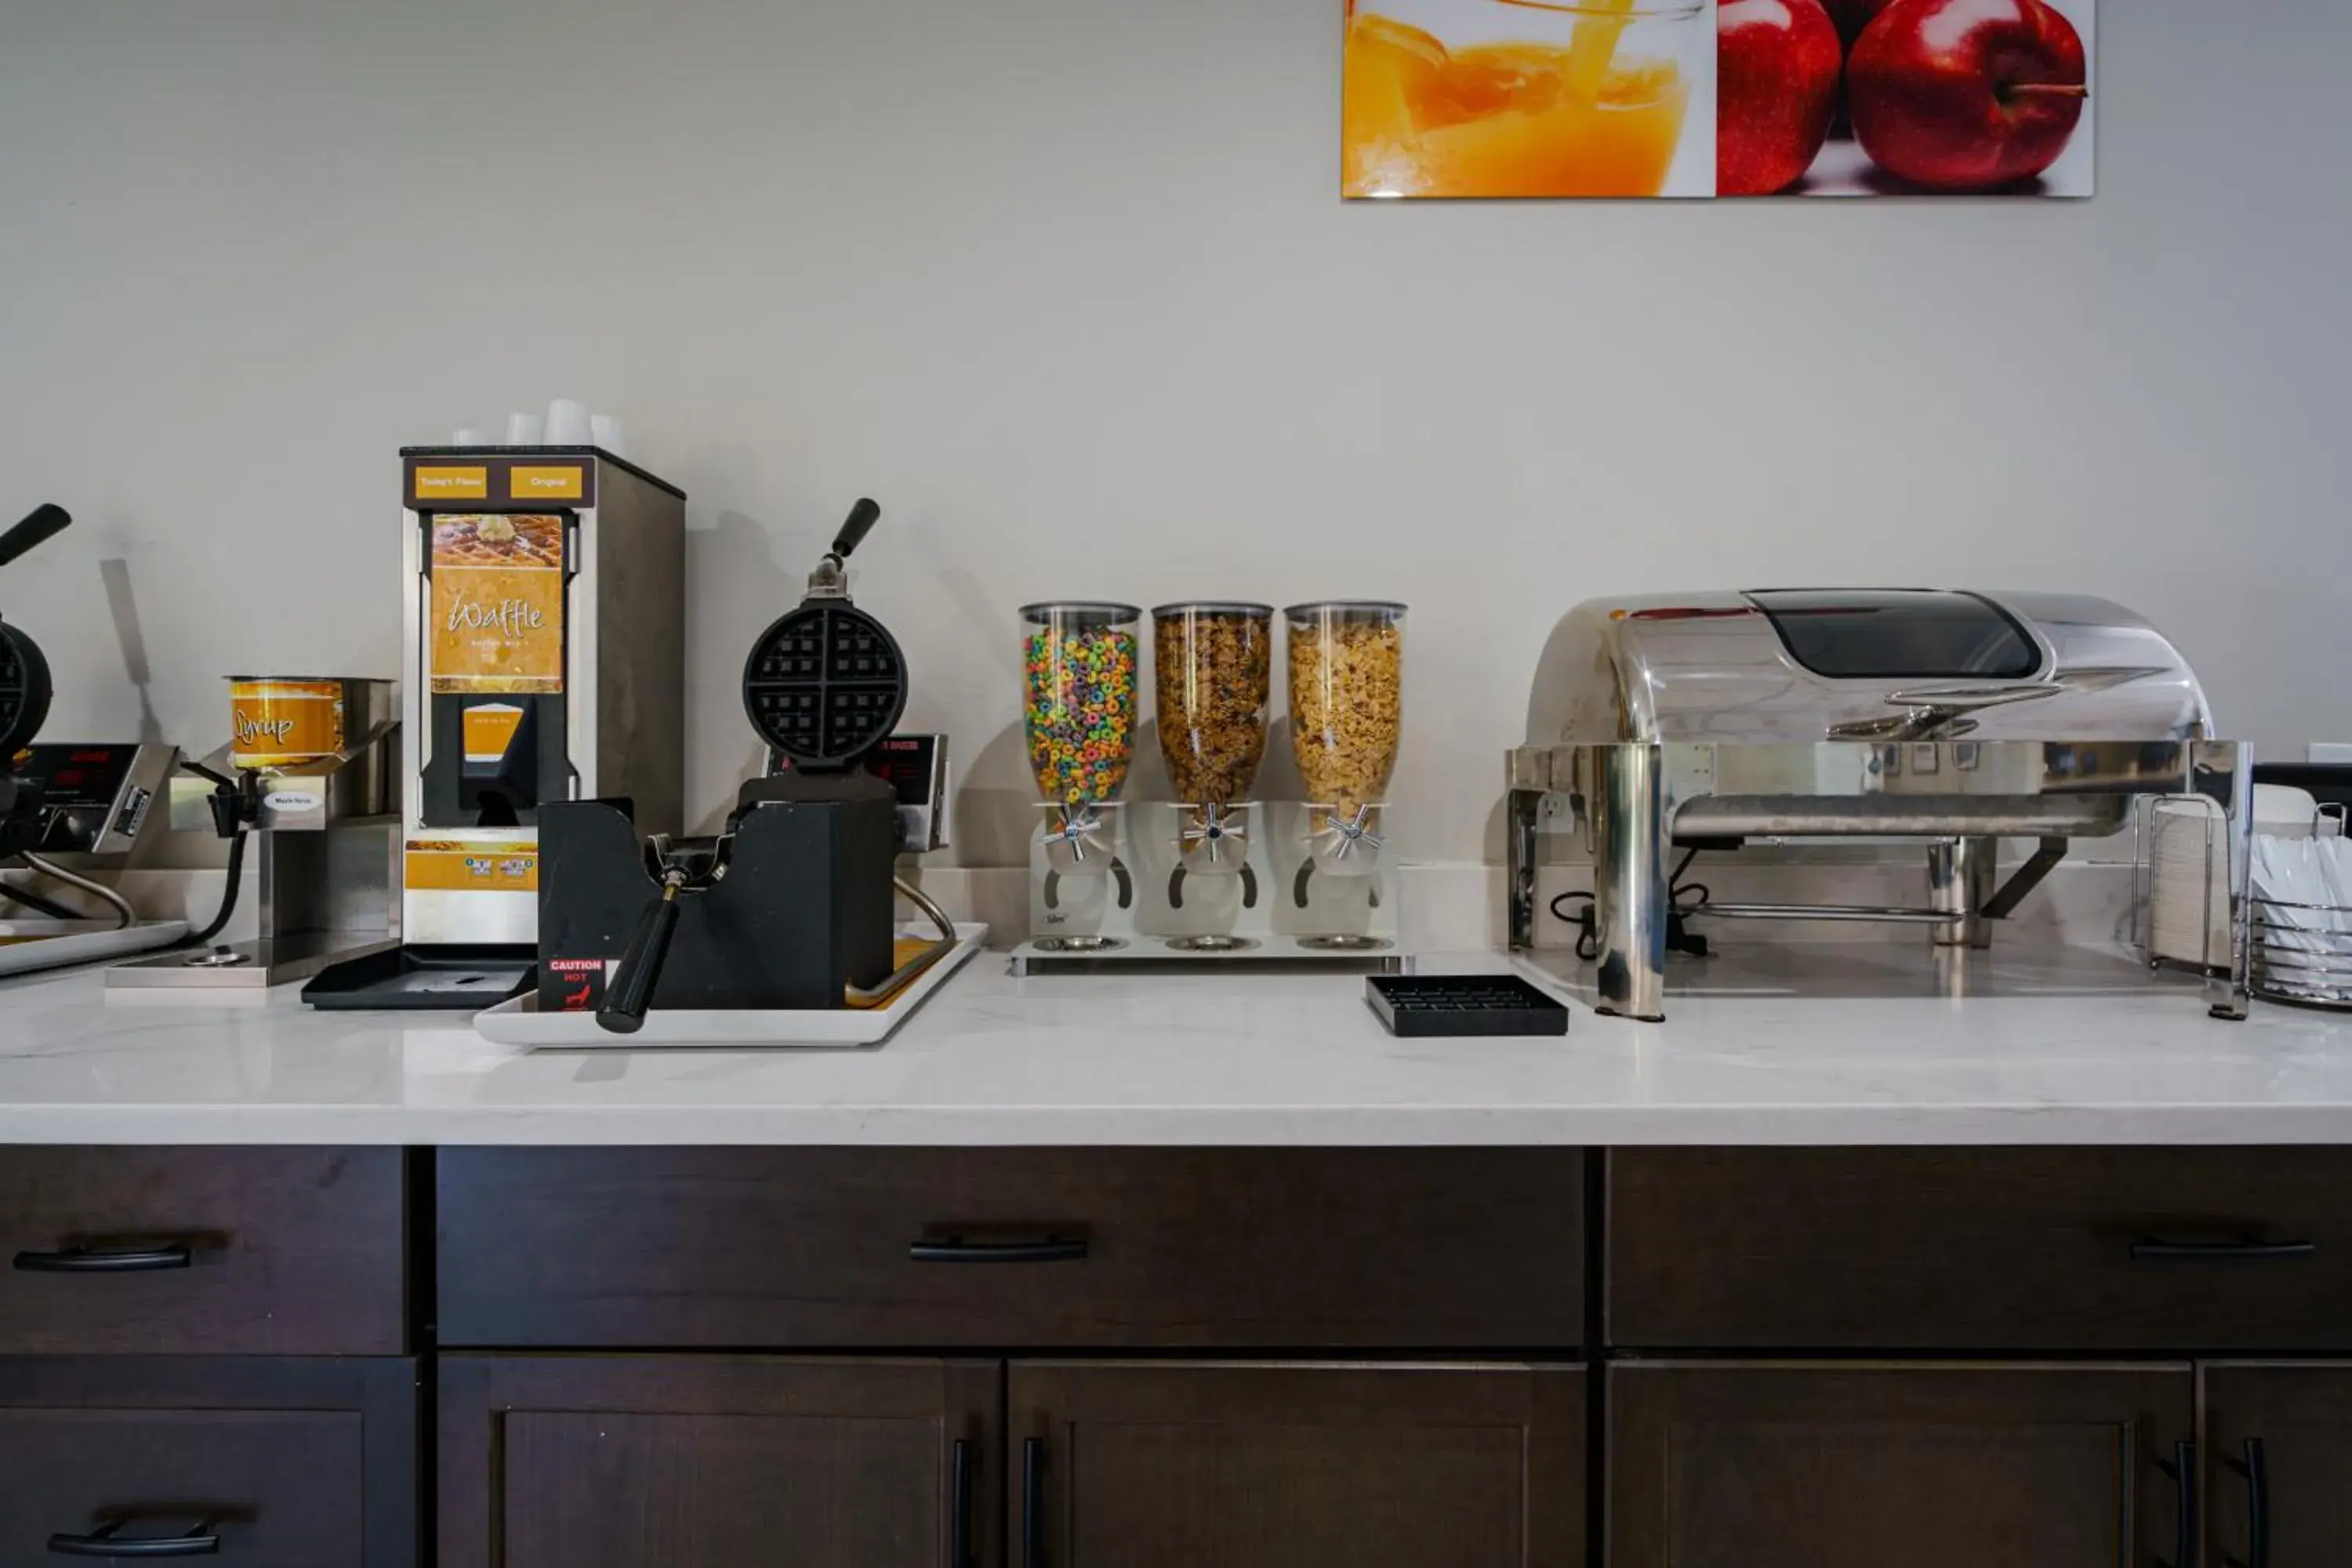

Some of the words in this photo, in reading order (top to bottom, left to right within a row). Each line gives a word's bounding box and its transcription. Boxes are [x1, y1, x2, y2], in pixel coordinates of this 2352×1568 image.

[448, 591, 543, 637] Waffle
[237, 709, 293, 744] Syrup
[551, 960, 601, 970] CAUTION
